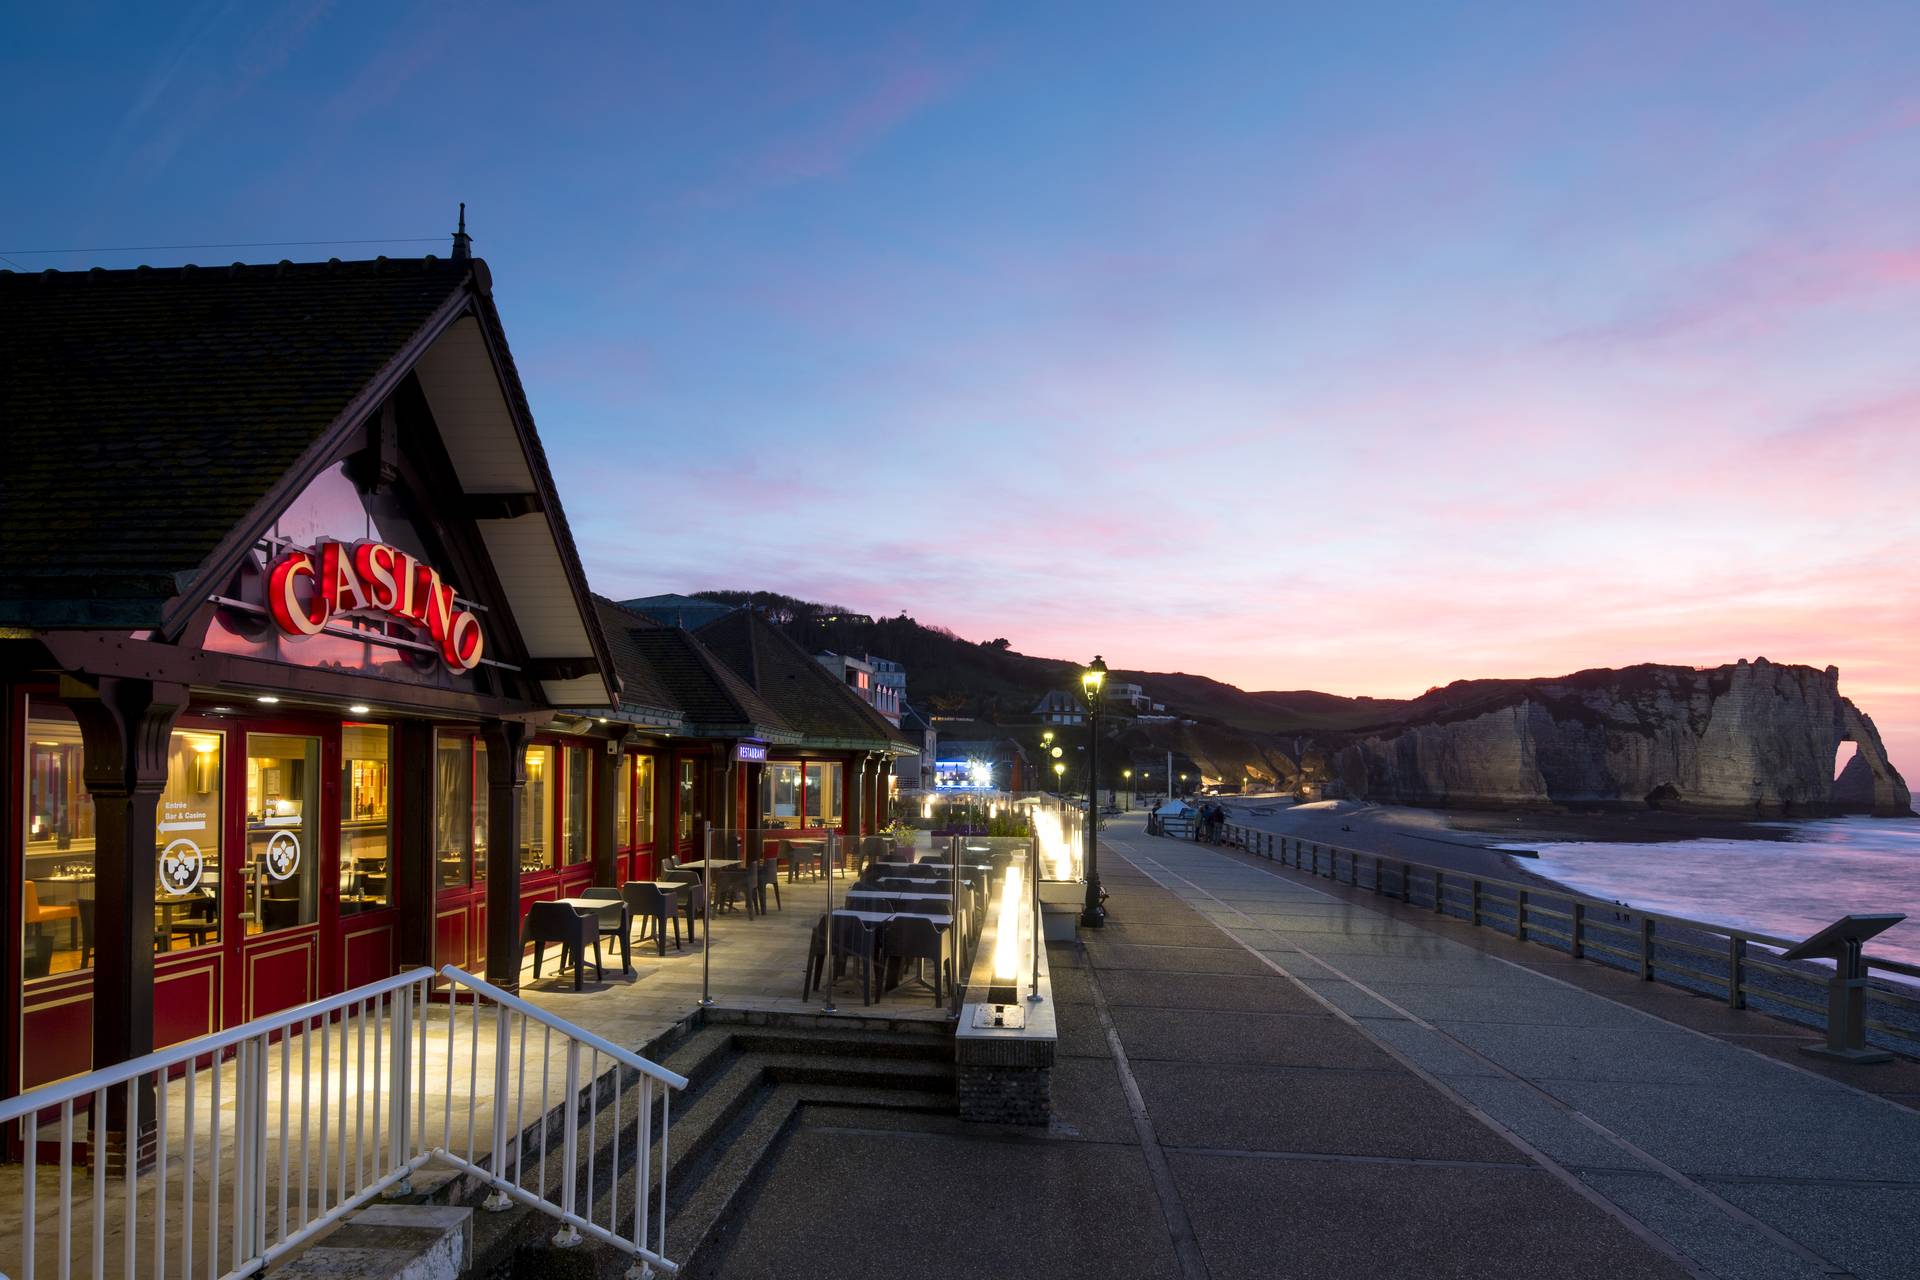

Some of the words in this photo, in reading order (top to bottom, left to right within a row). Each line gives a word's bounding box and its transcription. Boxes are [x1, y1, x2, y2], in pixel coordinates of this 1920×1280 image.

[266, 541, 484, 671] CASINO
[740, 746, 765, 759] RESTAURANT
[165, 812, 177, 820] Bar
[185, 811, 207, 820] Casino
